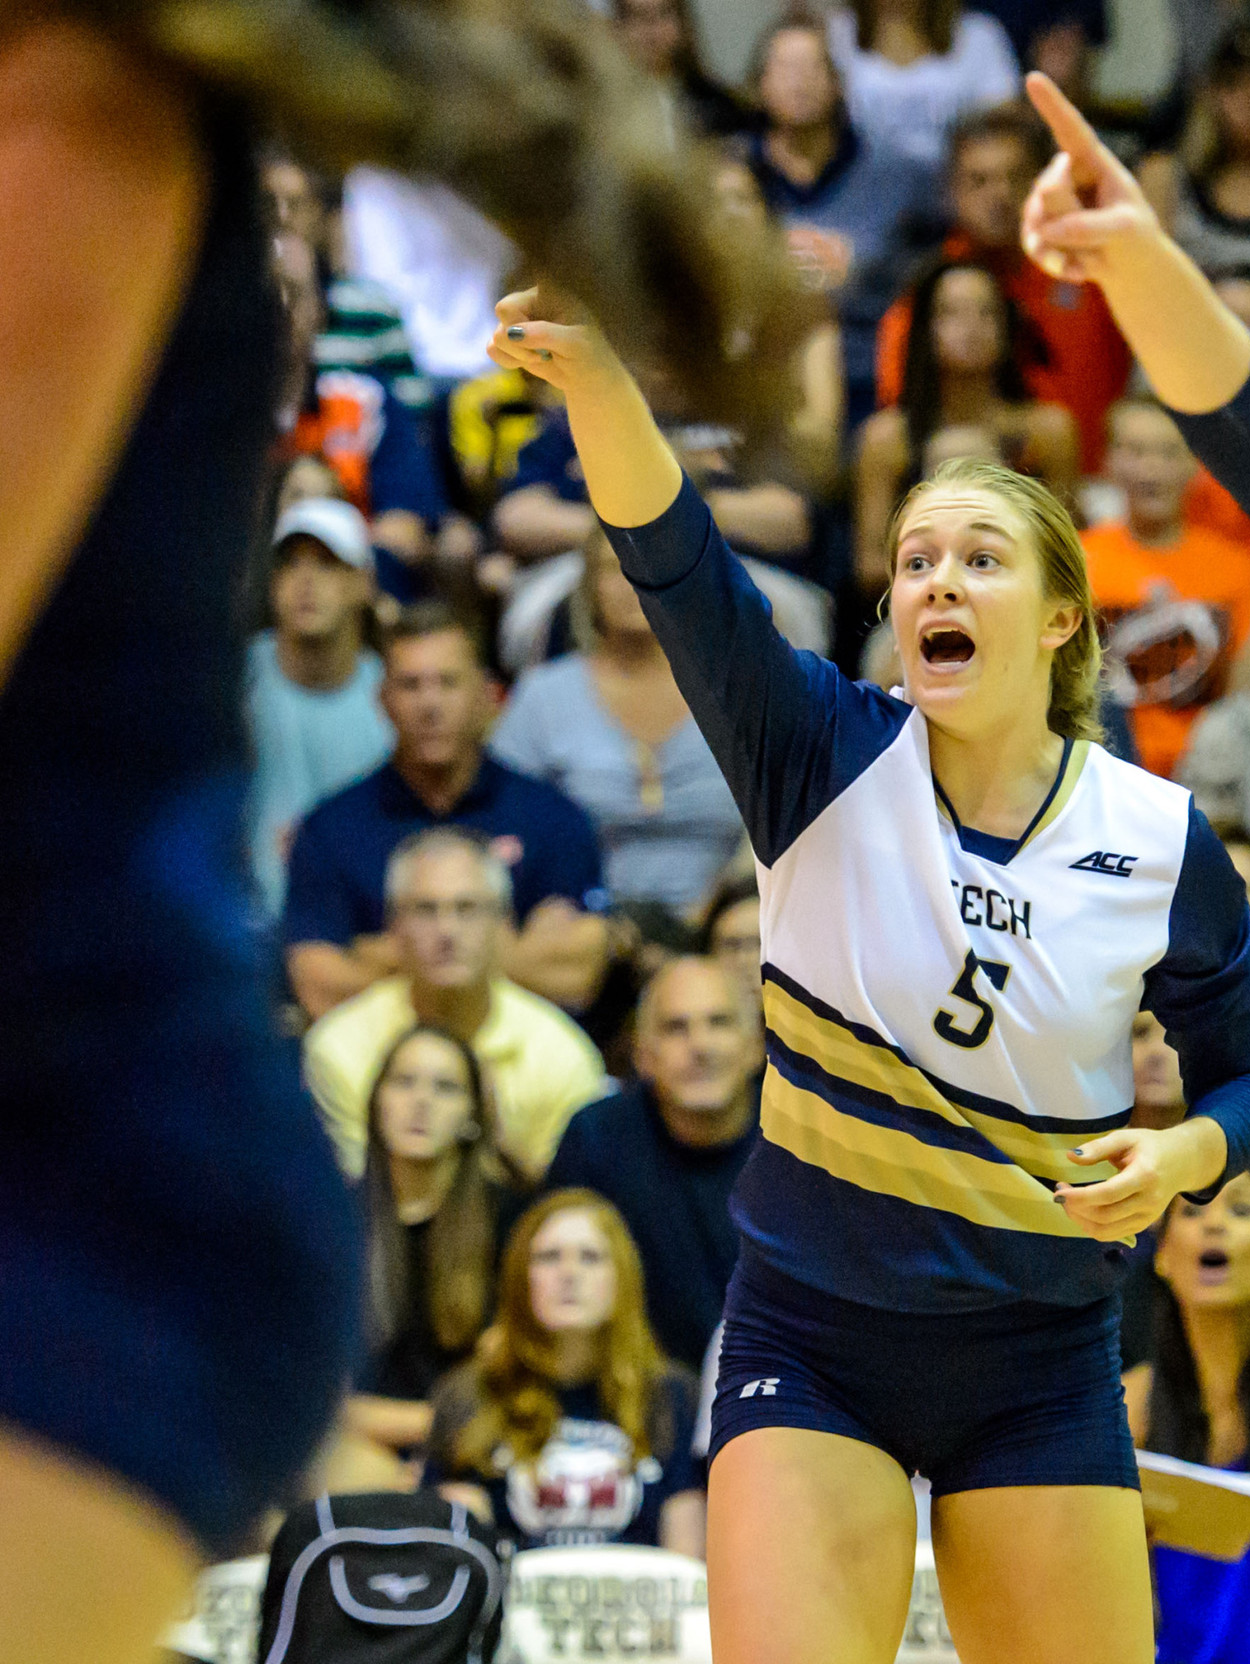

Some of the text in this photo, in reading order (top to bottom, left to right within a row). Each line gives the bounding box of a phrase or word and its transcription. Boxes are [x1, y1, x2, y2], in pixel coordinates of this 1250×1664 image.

[1068, 850, 1139, 878] ACC
[950, 879, 1032, 940] ECH
[931, 947, 1013, 1050] 5
